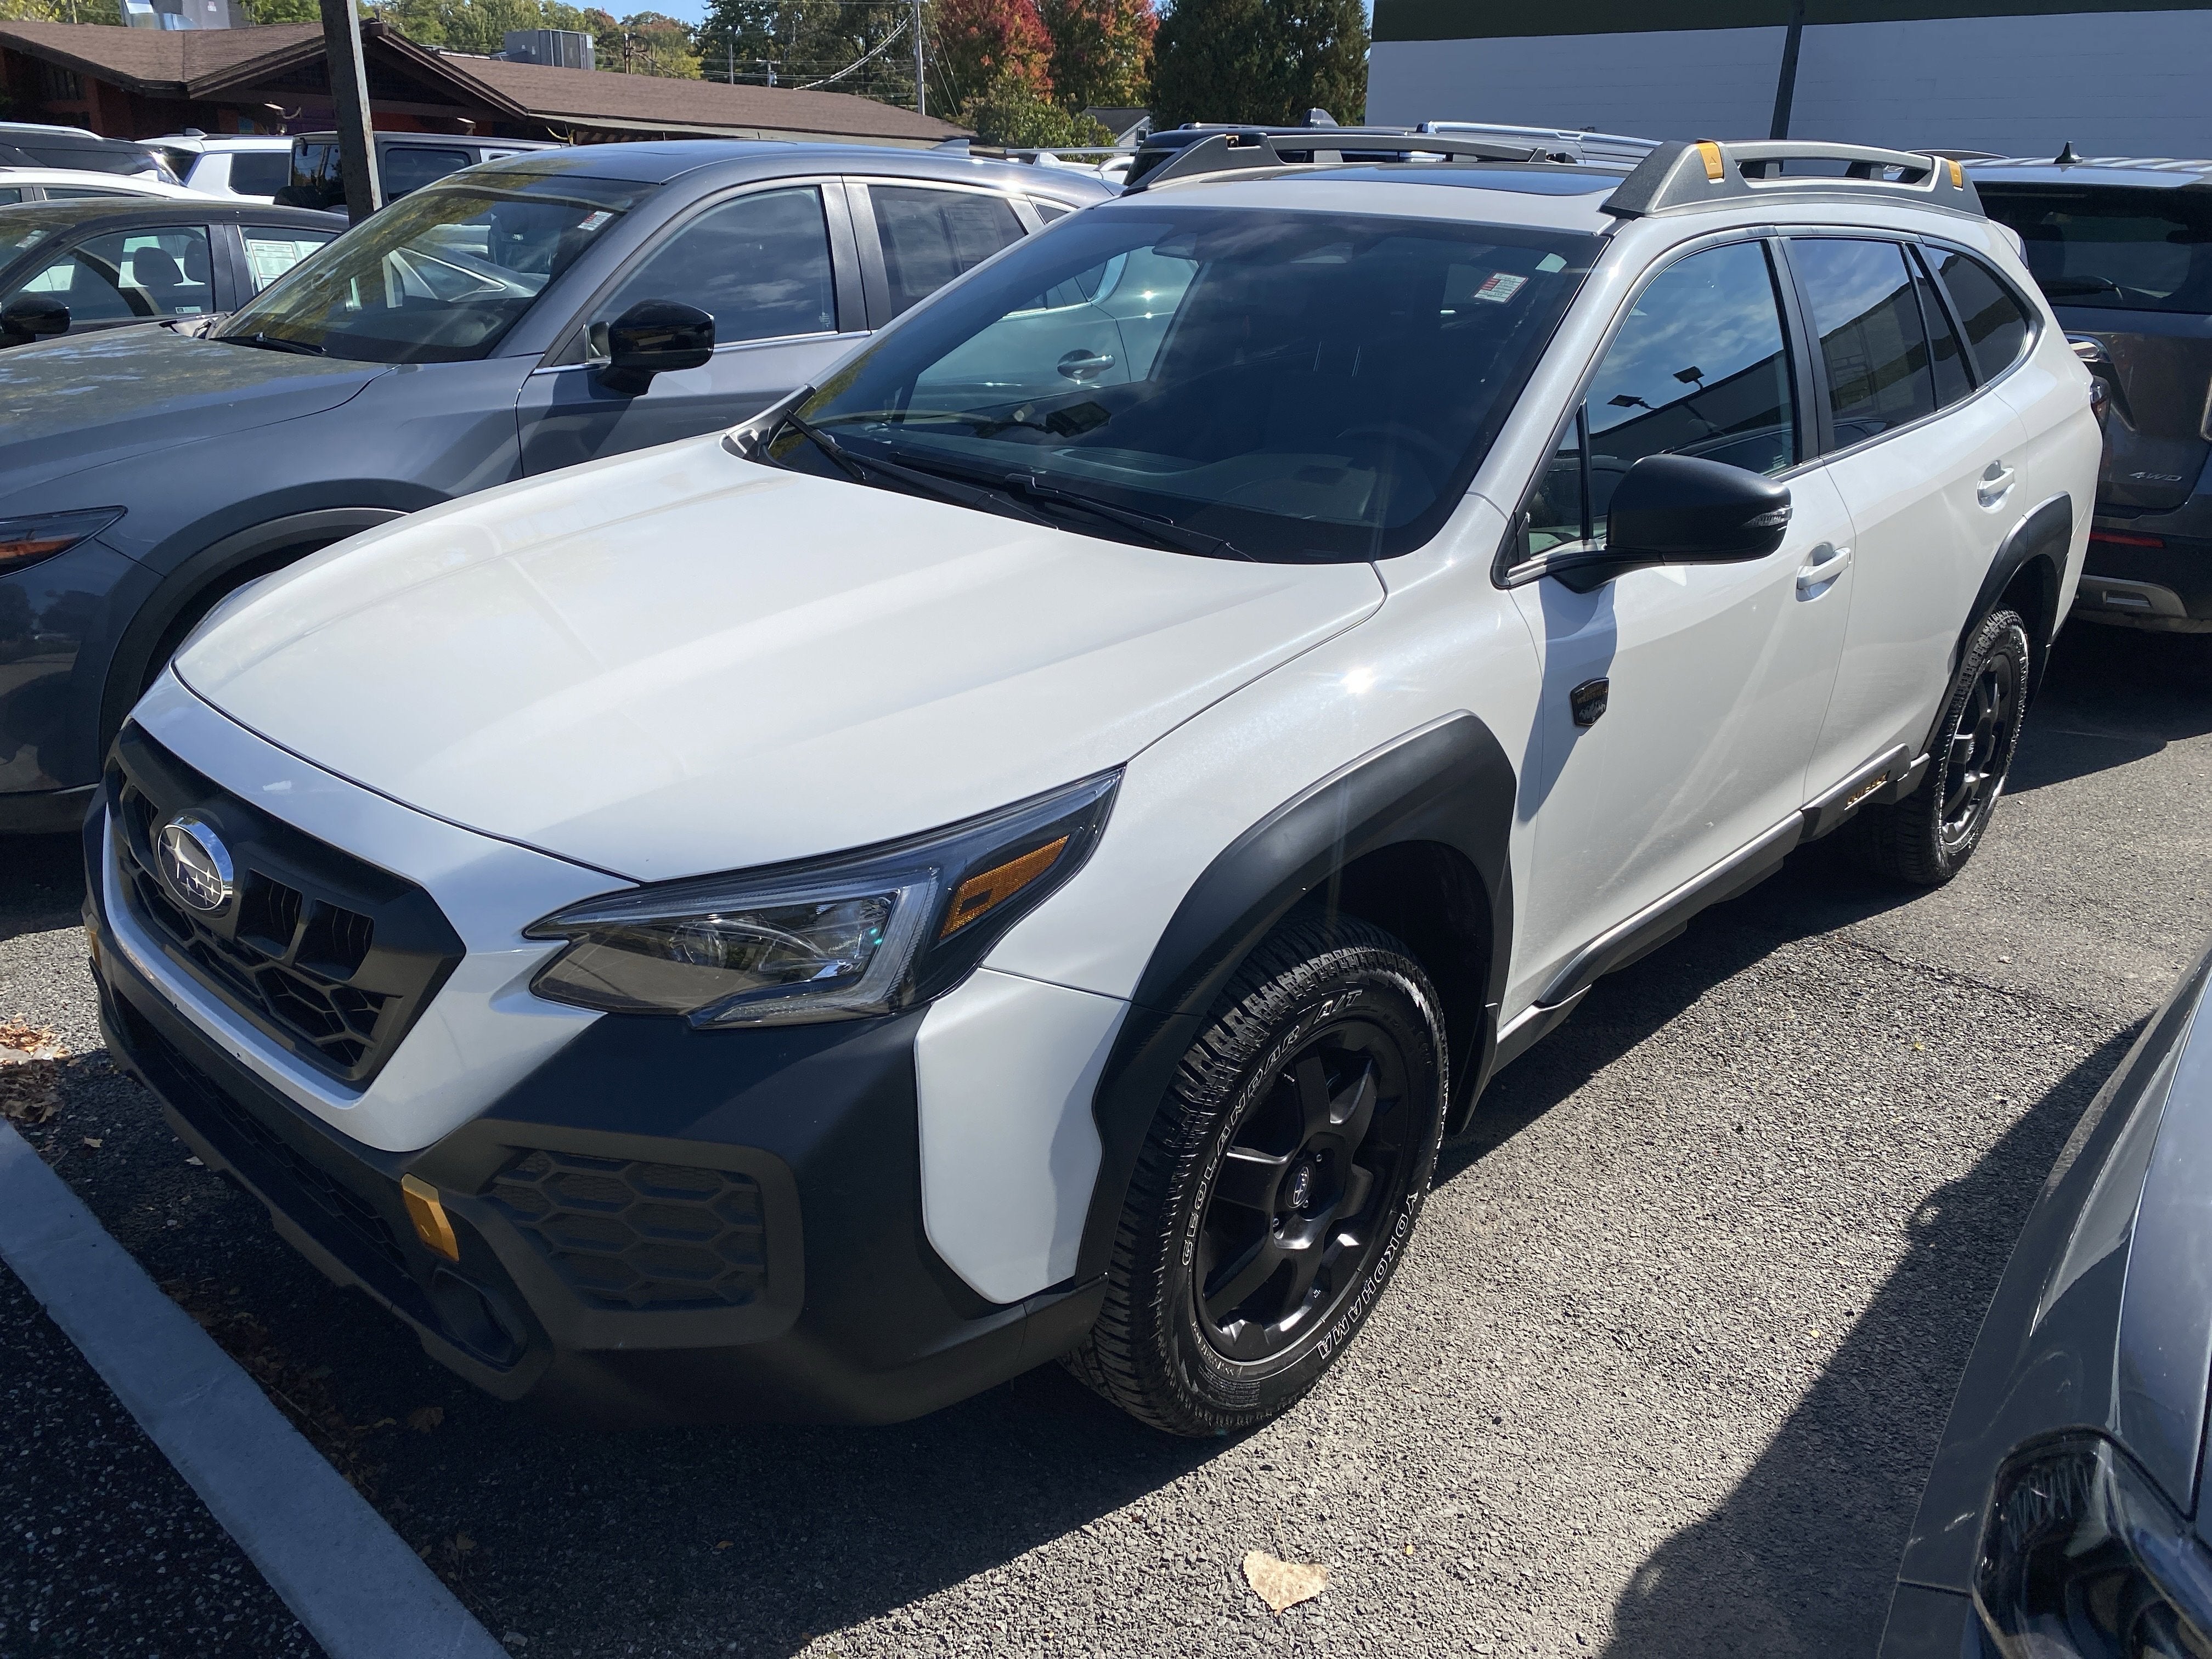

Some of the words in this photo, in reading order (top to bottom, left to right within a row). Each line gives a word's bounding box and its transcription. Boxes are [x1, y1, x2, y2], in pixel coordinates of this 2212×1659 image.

[2129, 471, 2182, 482] 4WD
[1181, 1024, 1301, 1266] GEOLANDAR
[1313, 989, 1363, 1025] A/T
[1318, 1189, 1419, 1360] YOKOHAMA
